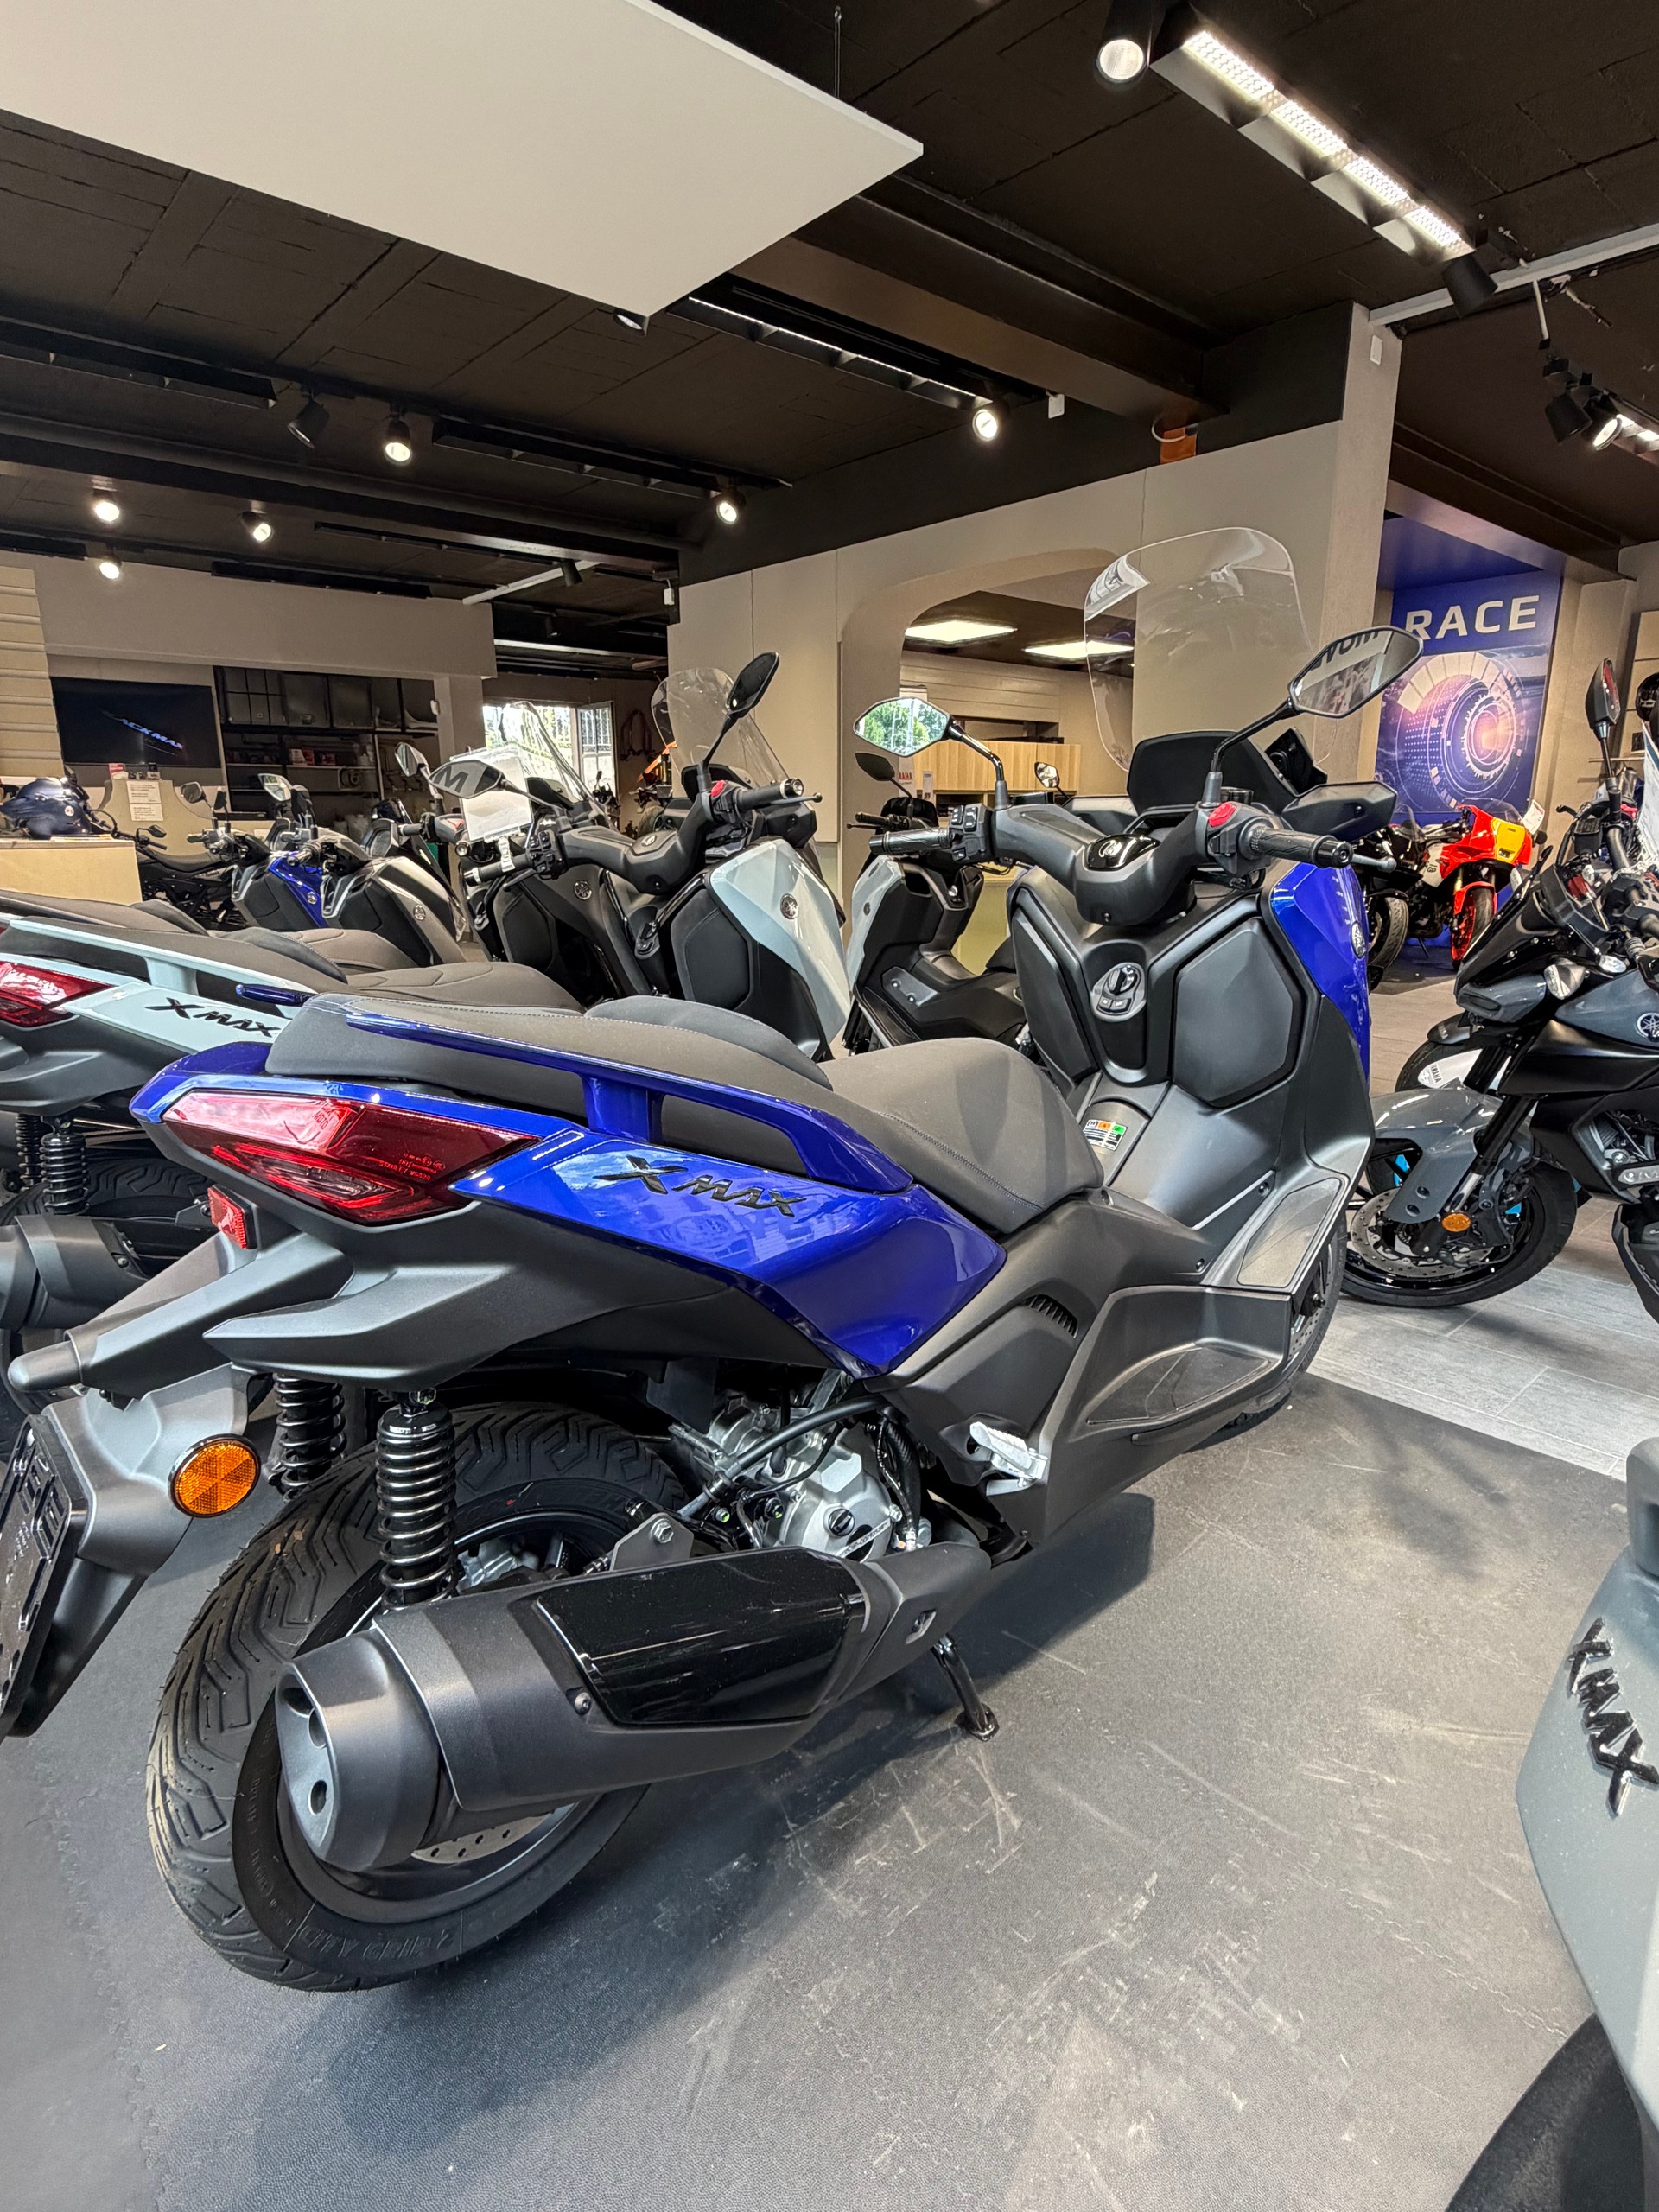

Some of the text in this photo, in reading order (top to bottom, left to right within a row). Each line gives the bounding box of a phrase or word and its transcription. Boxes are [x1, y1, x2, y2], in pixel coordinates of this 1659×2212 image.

[1405, 594, 1540, 641] RACE
[144, 996, 282, 1038] XMAX
[592, 1154, 808, 1218] XMAX
